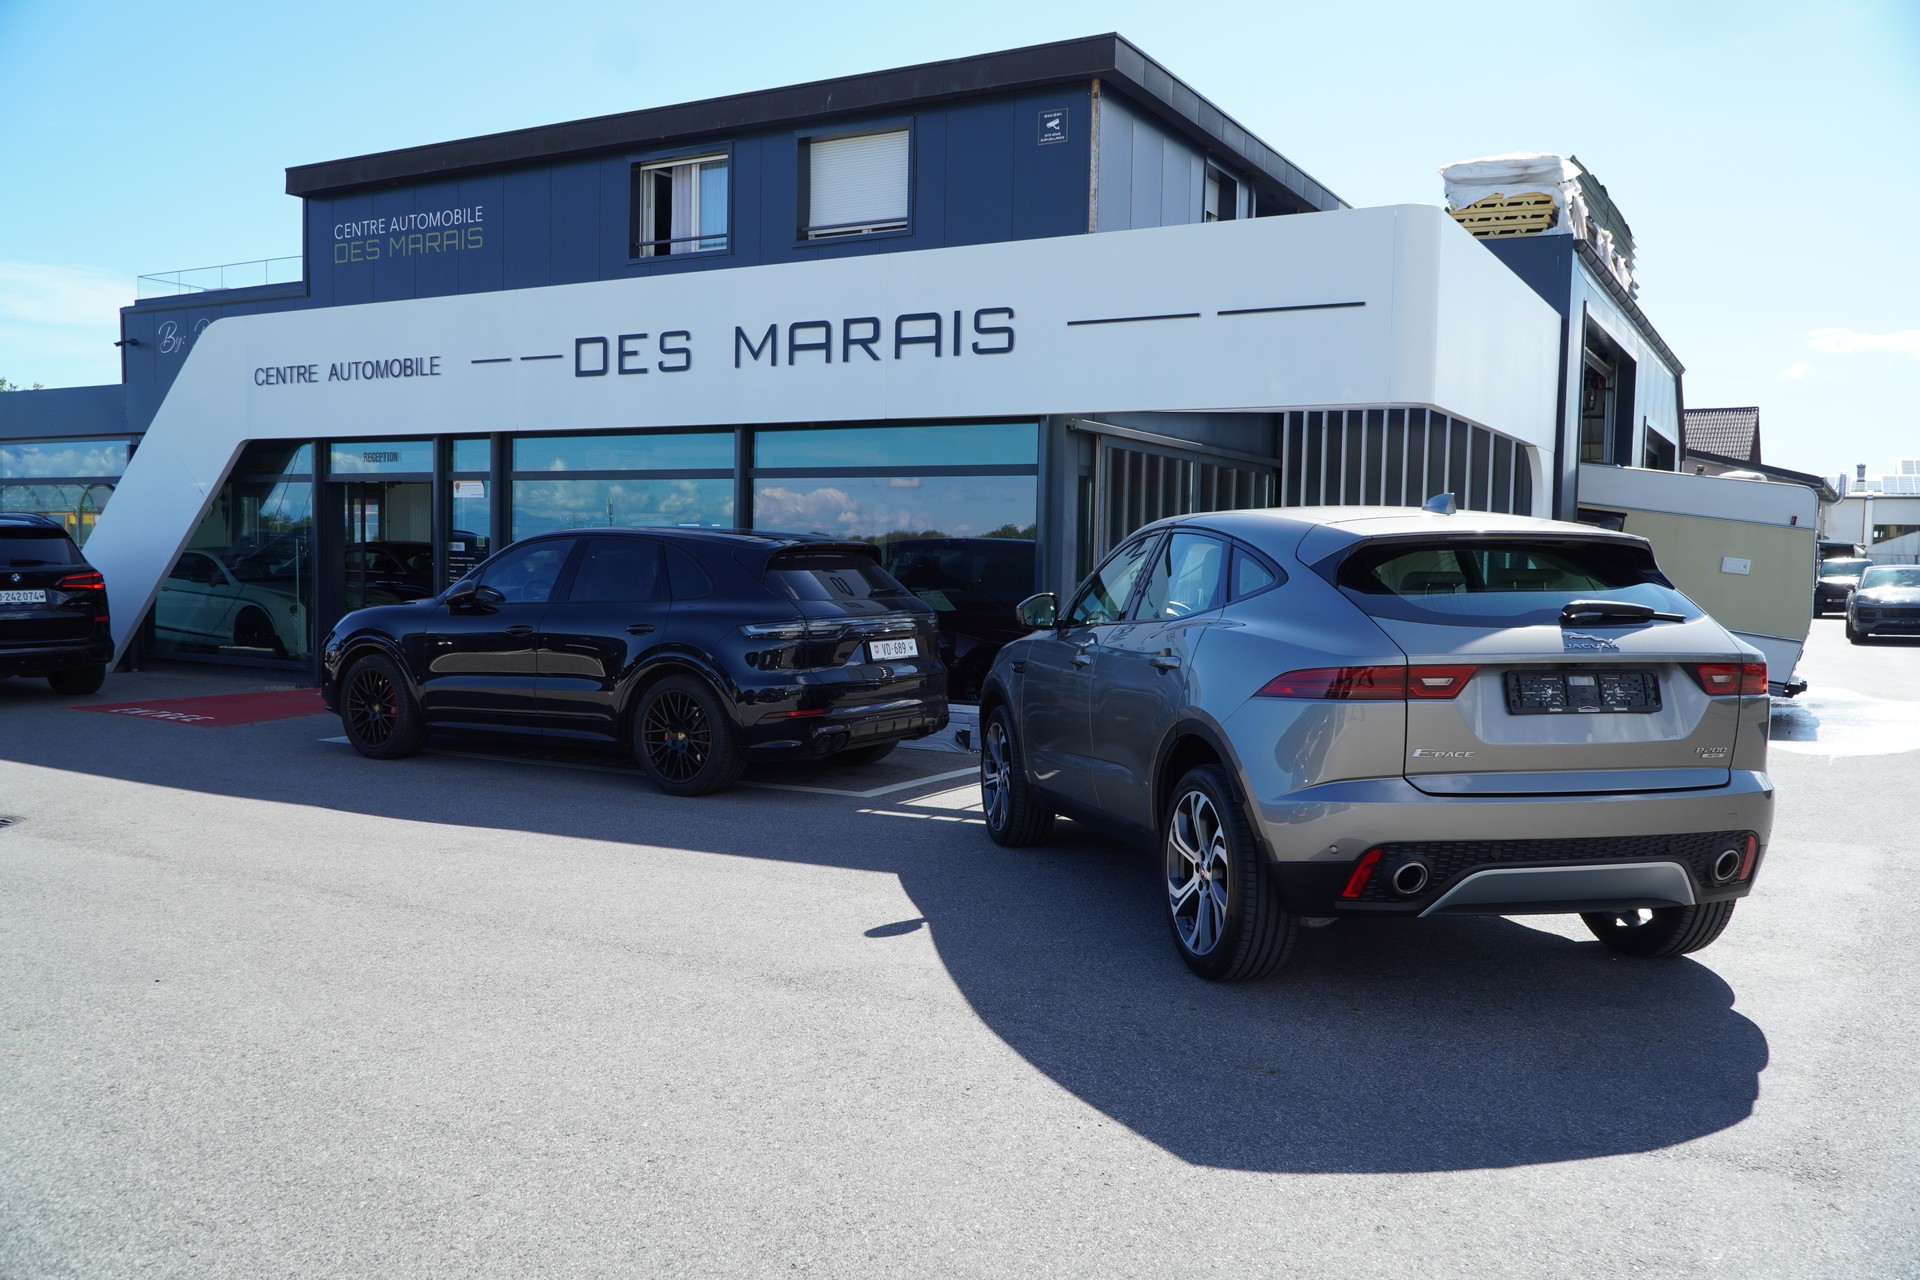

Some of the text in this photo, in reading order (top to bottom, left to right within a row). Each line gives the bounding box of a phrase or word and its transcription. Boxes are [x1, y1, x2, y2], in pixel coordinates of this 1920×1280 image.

[334, 205, 483, 240] CENTRE AUTOMOBILE
[334, 227, 483, 264] DES MARAIS
[574, 306, 1015, 378] DES MARAIS
[253, 355, 442, 387] CENTRE AUTOMOBILE
[363, 451, 400, 463] RECEPTION
